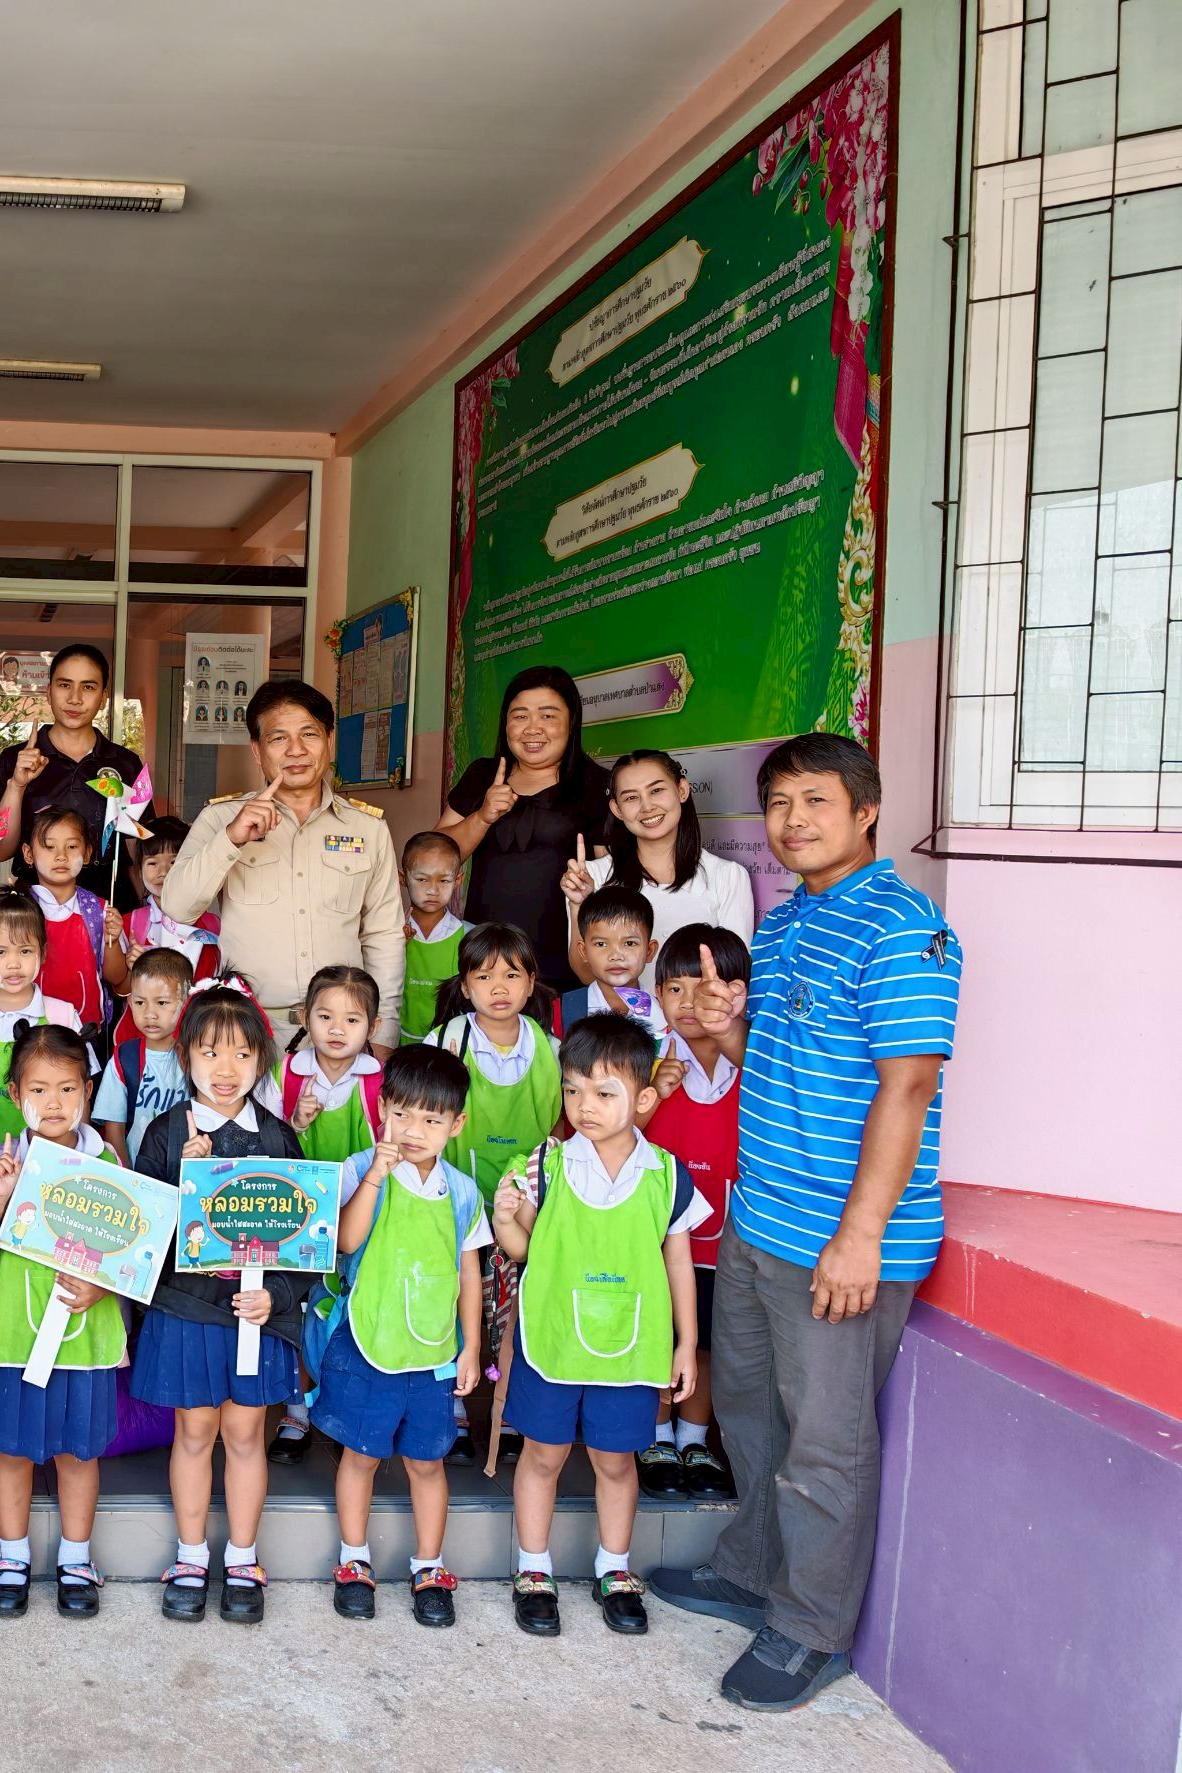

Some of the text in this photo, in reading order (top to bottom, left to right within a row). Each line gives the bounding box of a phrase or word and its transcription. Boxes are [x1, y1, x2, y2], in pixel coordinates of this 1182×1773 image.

[82, 1181, 118, 1201] โครงการ
[241, 1180, 277, 1190] โครงการ
[39, 1183, 151, 1235] หลอมรวมใจ
[200, 1189, 317, 1214] หลอมรวมใจ
[44, 1210, 130, 1247] มอบน้ำใสสะอาด ให้โรงเรียน
[212, 1216, 302, 1229] มอบน้ำใสสะอาด ให้โรงเรียน
